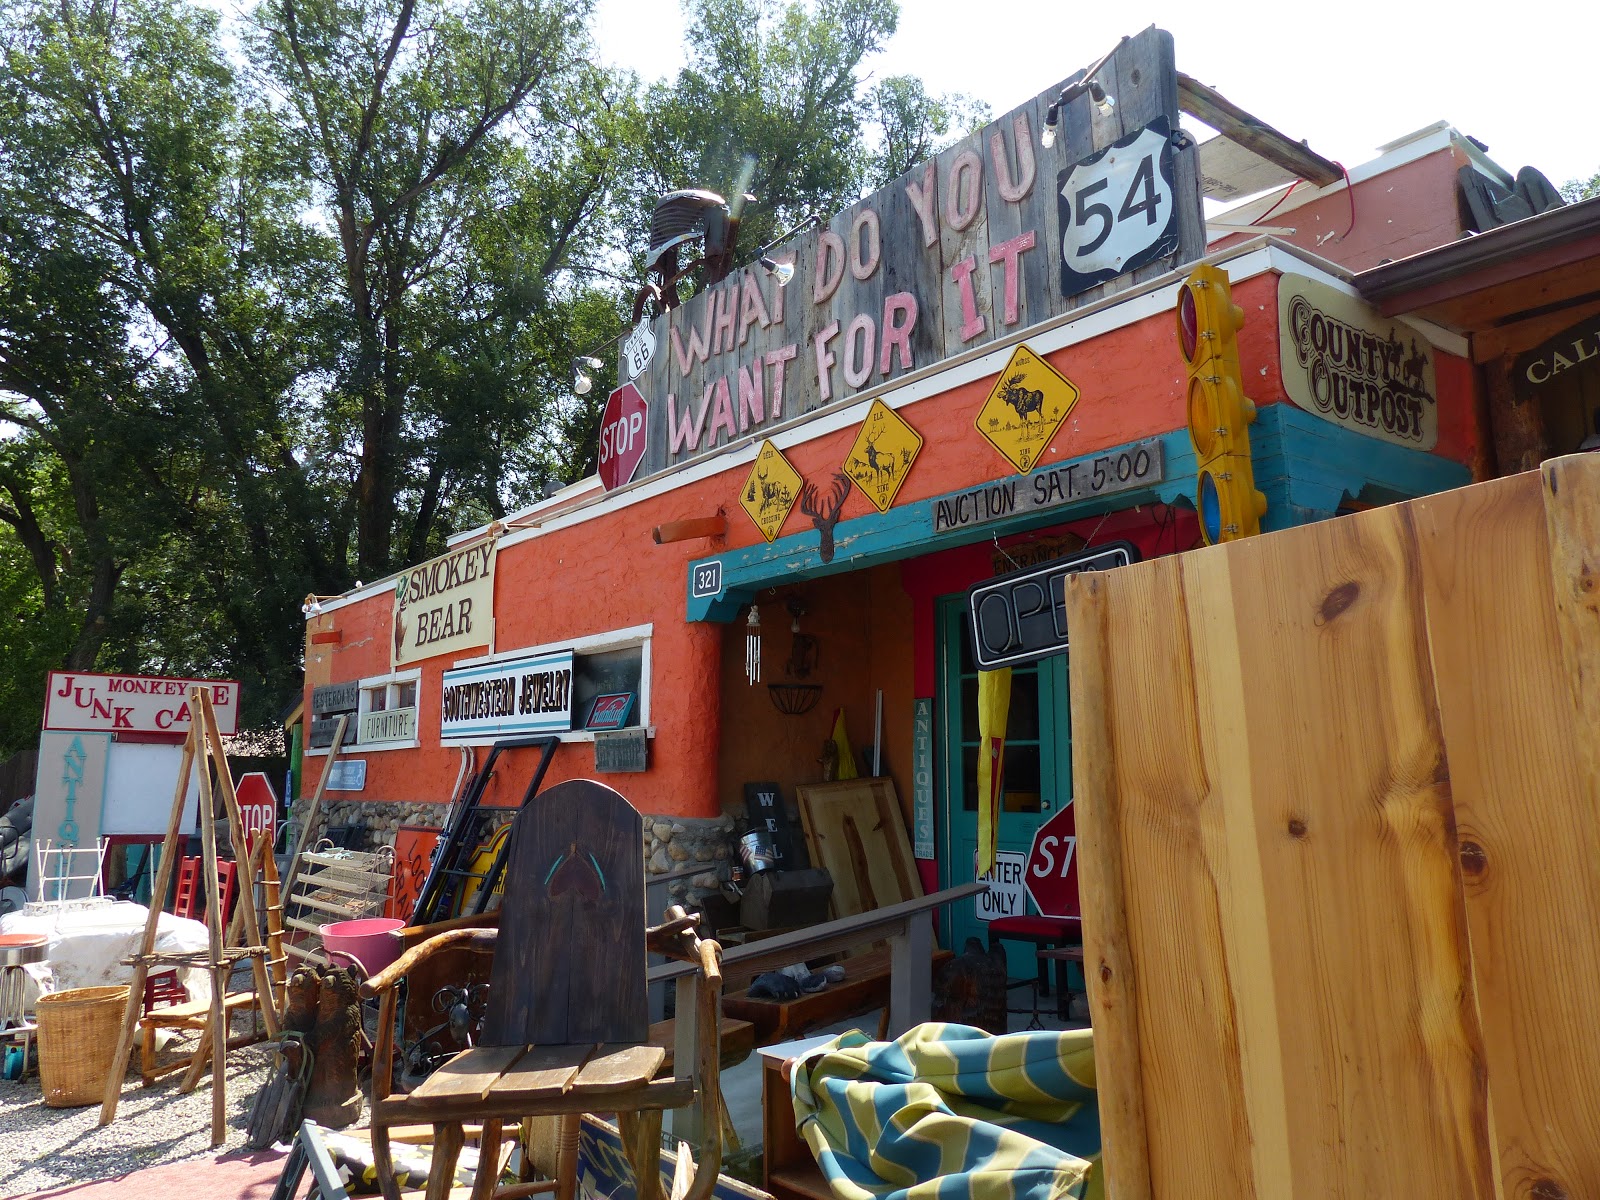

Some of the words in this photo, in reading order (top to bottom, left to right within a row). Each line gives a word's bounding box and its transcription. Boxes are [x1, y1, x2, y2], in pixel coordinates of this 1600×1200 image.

[1074, 153, 1162, 258] 54
[669, 251, 797, 377] WHAT
[813, 208, 881, 304] DO
[905, 111, 1037, 248] YOU
[634, 342, 649, 370] 66
[668, 343, 797, 454] WANT
[815, 291, 918, 401] FOR
[951, 229, 1037, 343] IT
[1288, 294, 1395, 382] COUNTY
[873, 411, 884, 421] ELK
[1307, 355, 1424, 441] OUTPOST
[601, 411, 643, 465] STOP
[876, 483, 889, 494] XING
[936, 481, 1016, 531] AUCTION
[1091, 449, 1151, 492] 5:00
[408, 539, 497, 604] SMOKEY
[698, 568, 716, 590] 321
[414, 597, 473, 647] BEAR
[978, 556, 1108, 656] OPE
[57, 677, 135, 729] JUNK
[155, 685, 230, 729] CAE
[108, 678, 189, 696] MONKEY
[443, 676, 516, 723] SOUTHWESTERN
[519, 668, 571, 715] JEWELRY
[366, 713, 409, 739] FURNITURE
[916, 702, 929, 839] ANTIQUES
[240, 804, 273, 836] TOP
[757, 792, 784, 870] WEL
[916, 849, 933, 858] TRADE
[978, 861, 1022, 884] TER
[982, 890, 1017, 915] ONLY
